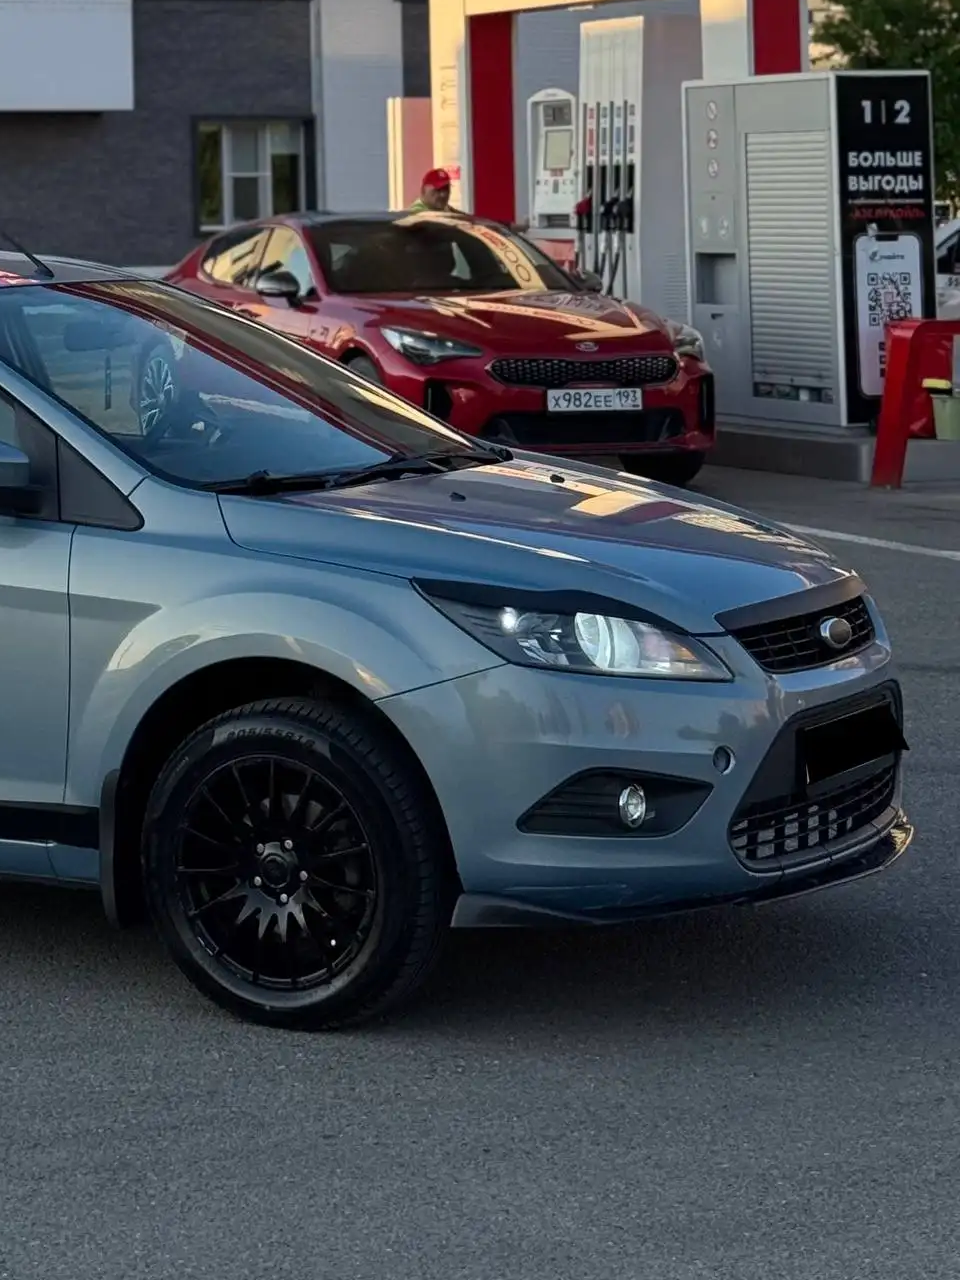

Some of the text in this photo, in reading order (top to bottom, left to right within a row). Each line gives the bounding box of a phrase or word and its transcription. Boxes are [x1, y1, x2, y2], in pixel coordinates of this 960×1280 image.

[861, 99, 911, 124] 1 2
[848, 151, 923, 168] БОЛЬШЕ
[848, 174, 924, 194] ВЫГОДЫ
[616, 390, 638, 404] 193
